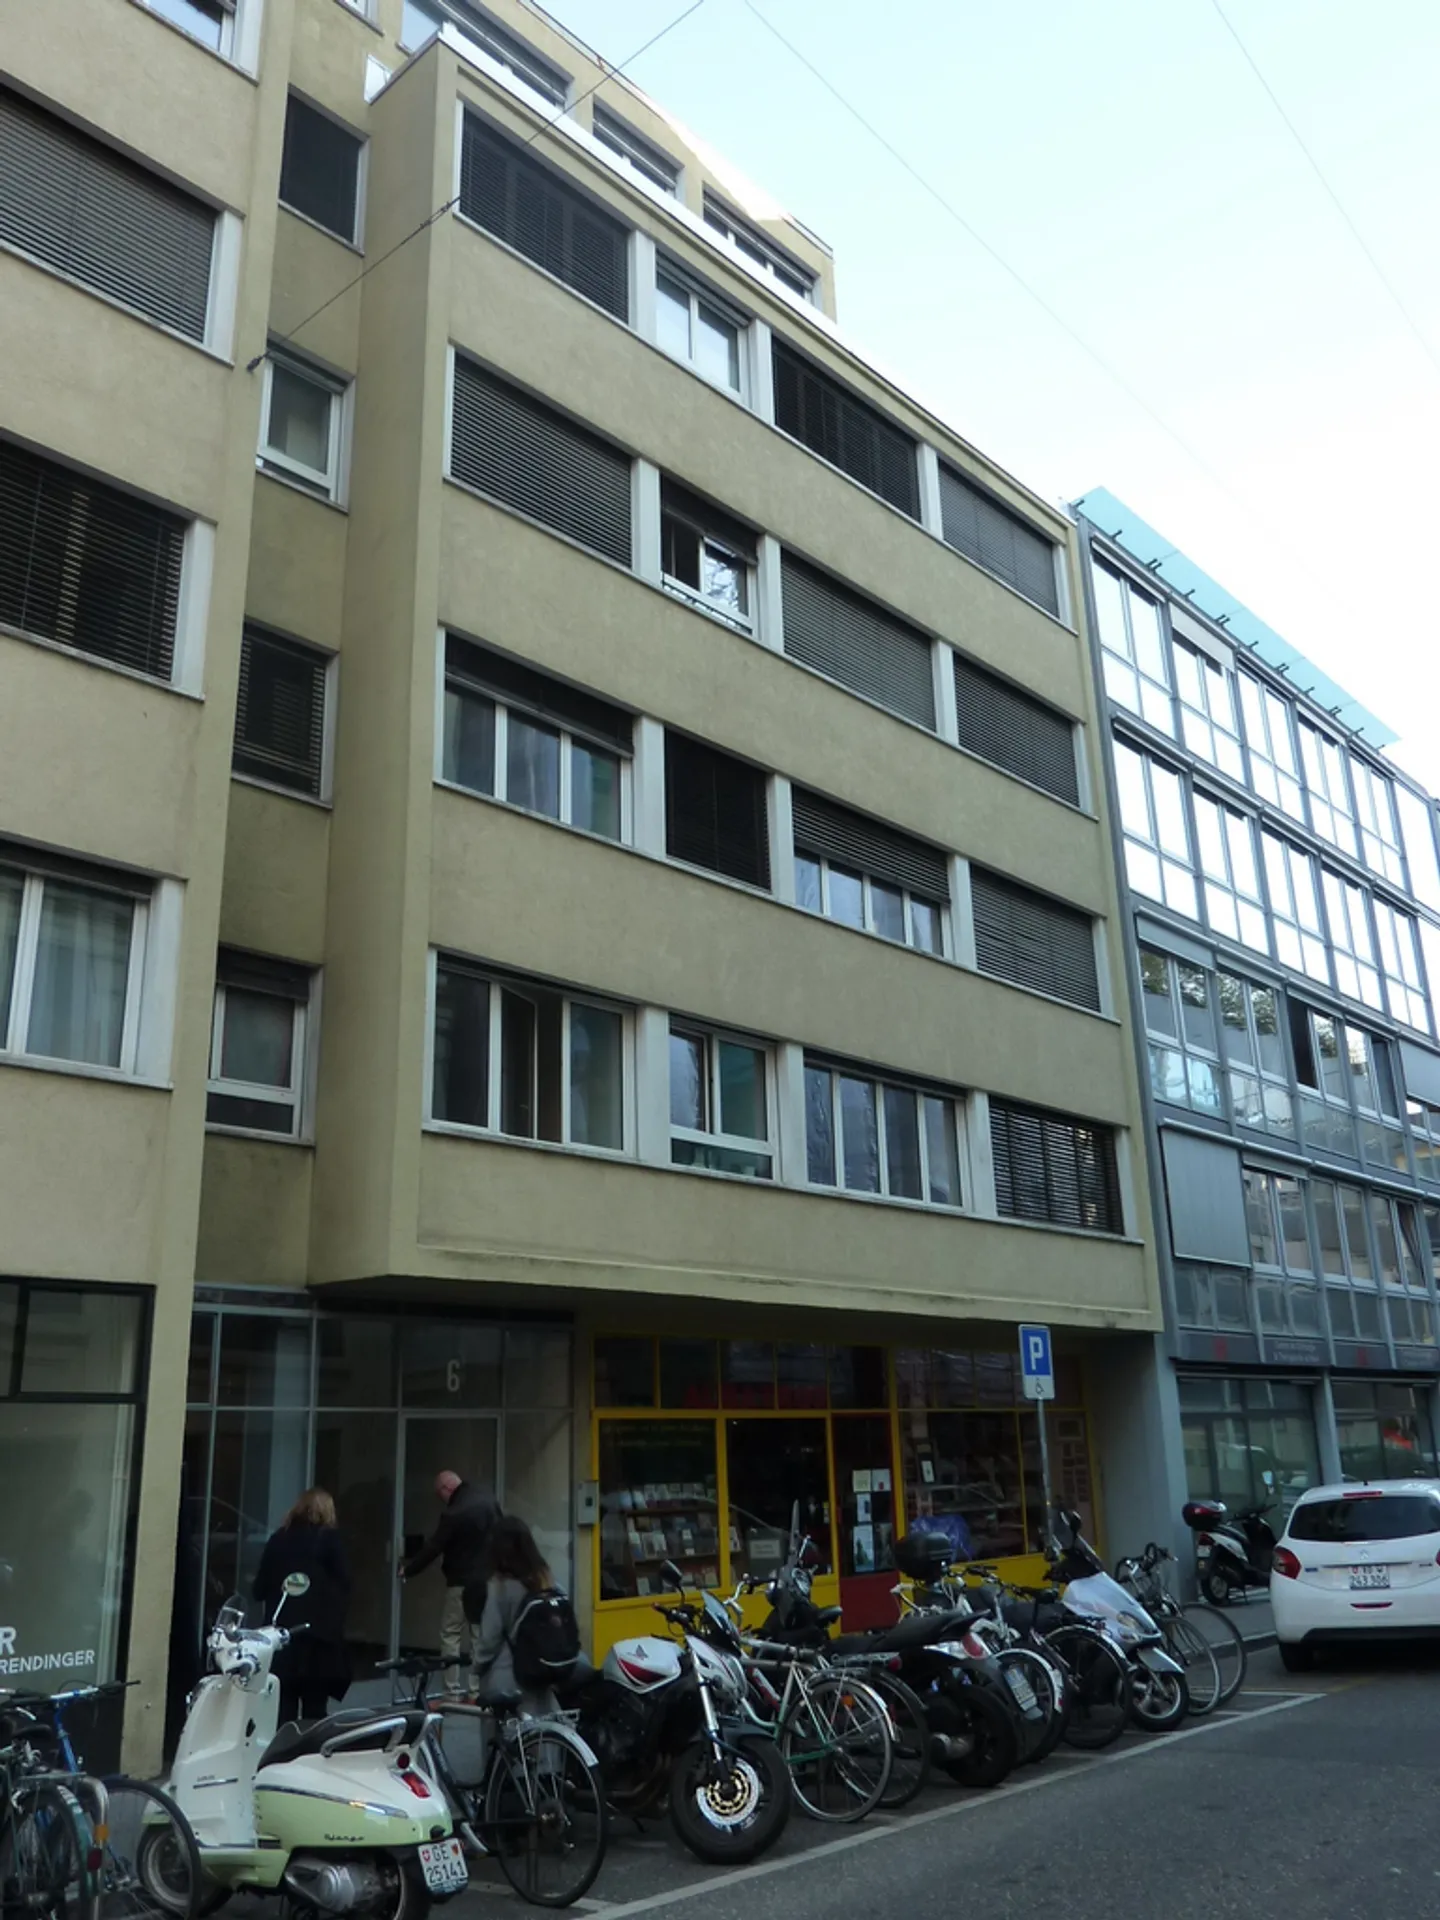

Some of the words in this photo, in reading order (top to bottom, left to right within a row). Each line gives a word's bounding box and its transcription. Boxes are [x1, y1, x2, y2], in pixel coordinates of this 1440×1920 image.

[1029, 1336, 1044, 1370] P
[447, 1359, 460, 1392] 6
[0, 1649, 96, 1674] RENDINGER
[432, 1844, 450, 1861] GE
[426, 1860, 466, 1884] 25141
